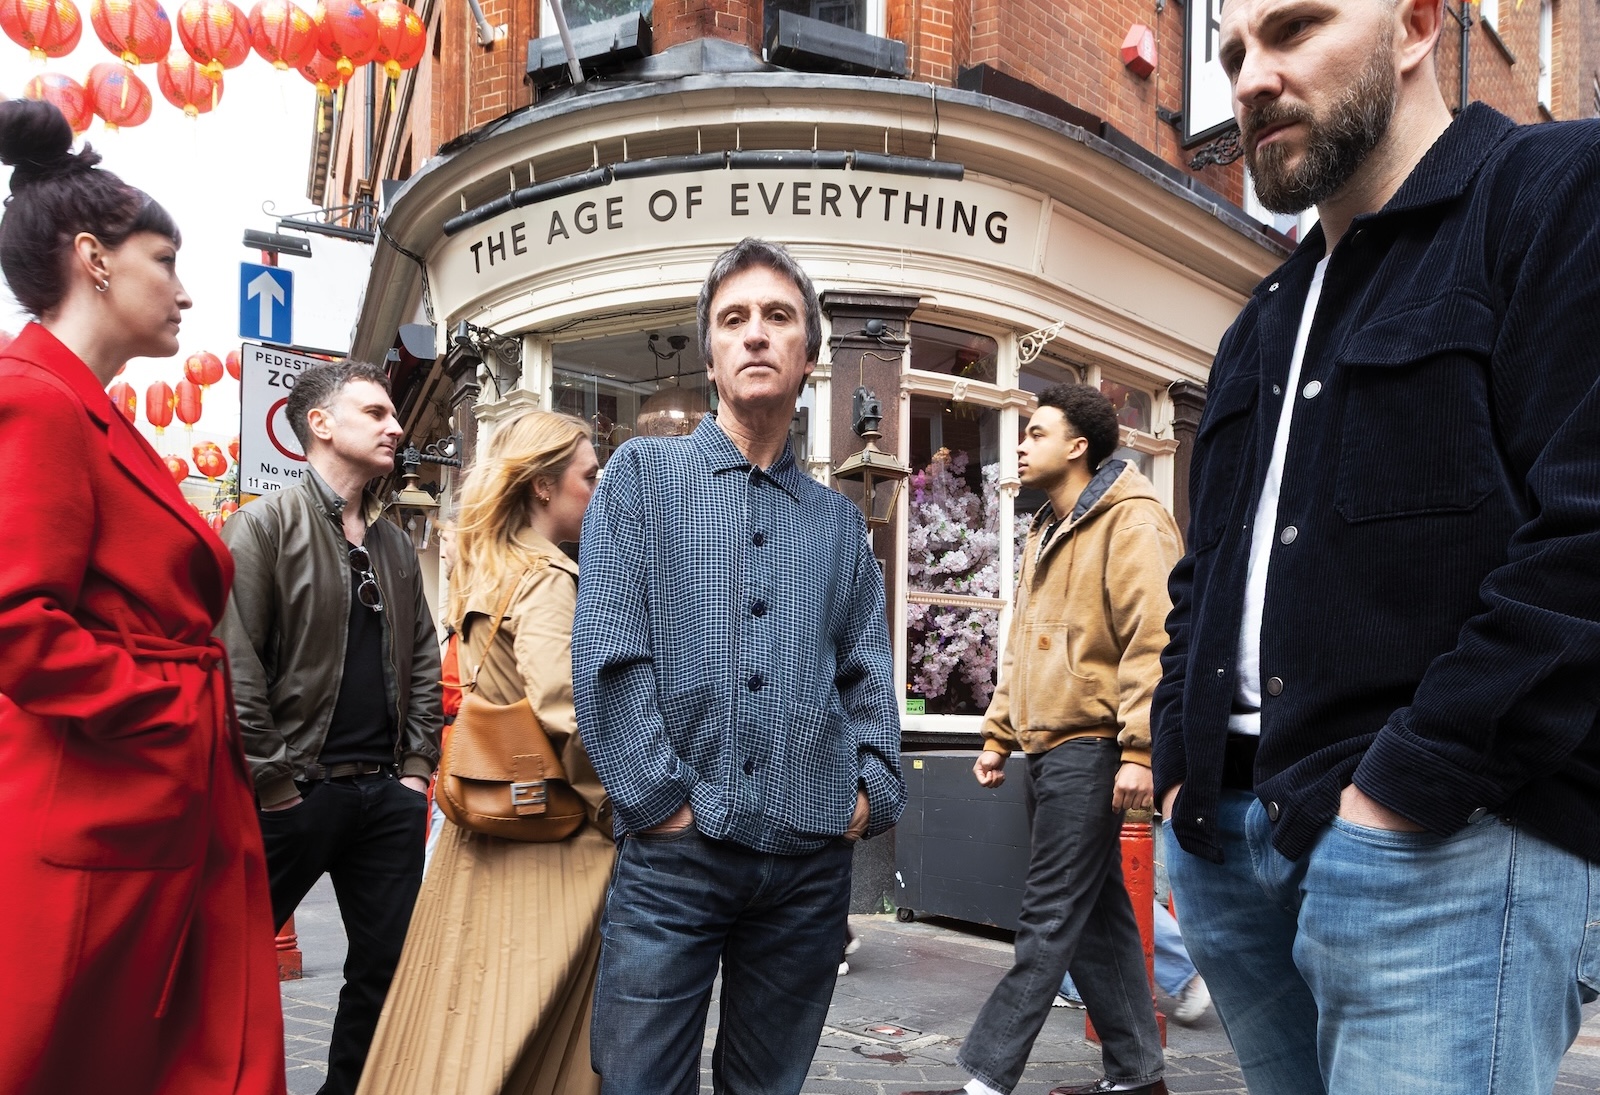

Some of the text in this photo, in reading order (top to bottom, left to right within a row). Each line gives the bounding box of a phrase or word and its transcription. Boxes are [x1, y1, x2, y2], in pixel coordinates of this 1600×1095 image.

[470, 182, 1008, 273] THE AGE OF EVERYTHING
[260, 462, 279, 475] No
[248, 477, 281, 491] 11 am
